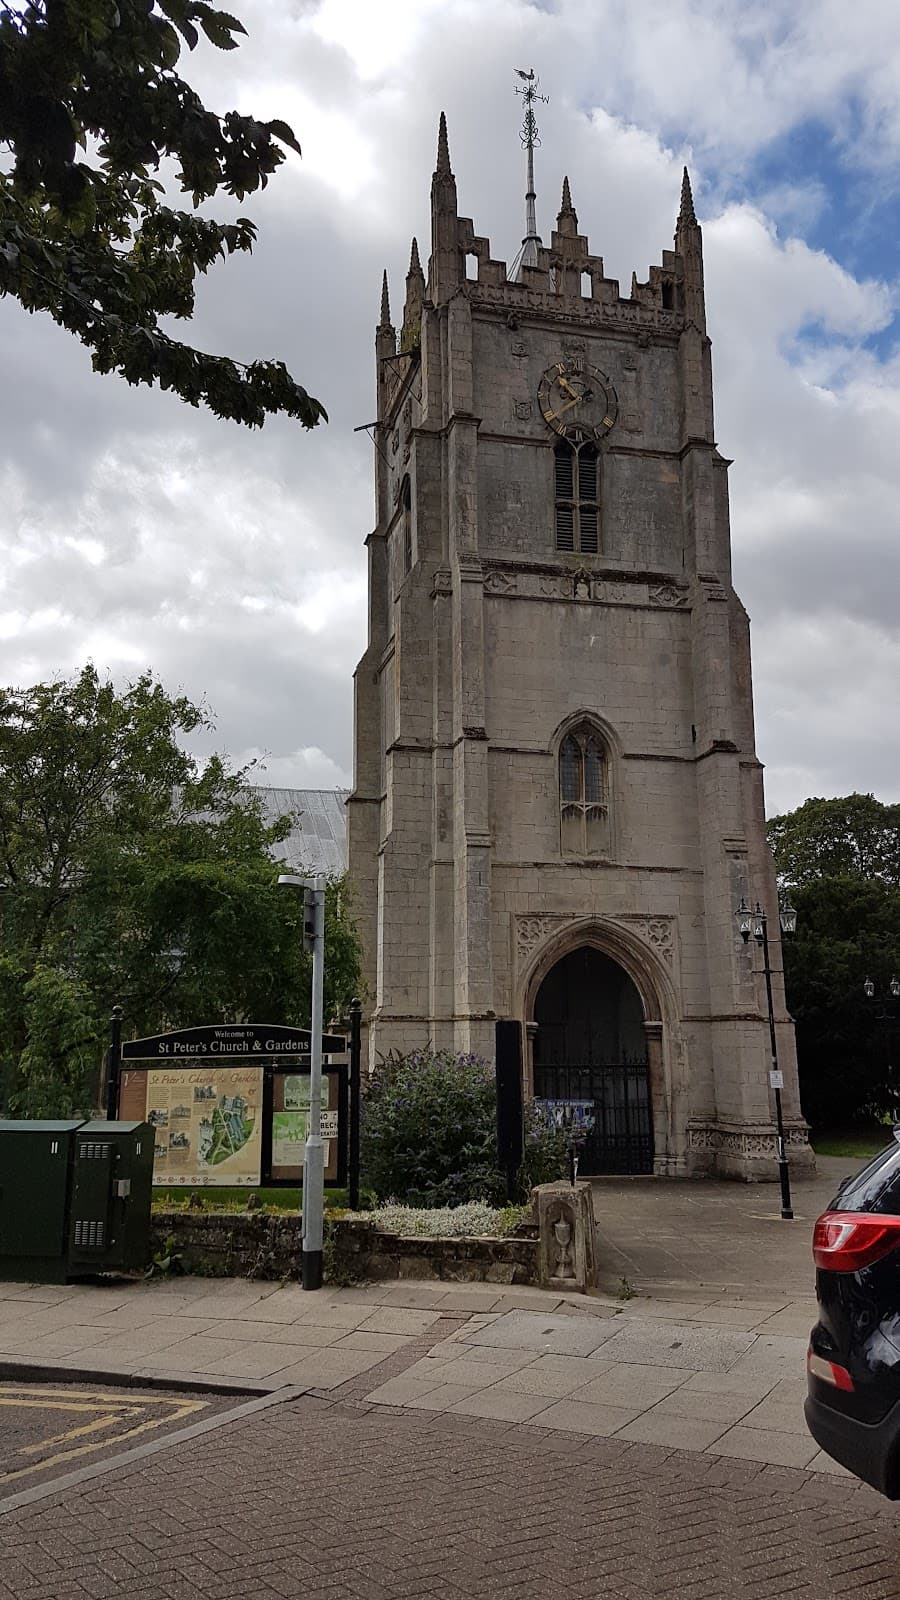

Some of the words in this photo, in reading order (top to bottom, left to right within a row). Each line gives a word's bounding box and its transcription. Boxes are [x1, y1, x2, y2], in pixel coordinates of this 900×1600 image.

[214, 1030, 245, 1038] Welcome
[246, 1030, 254, 1038] to
[158, 1042, 169, 1054] St
[173, 1041, 207, 1053] Peter's
[210, 1040, 249, 1052] Church
[252, 1040, 262, 1051] &
[265, 1039, 309, 1051] Gardens
